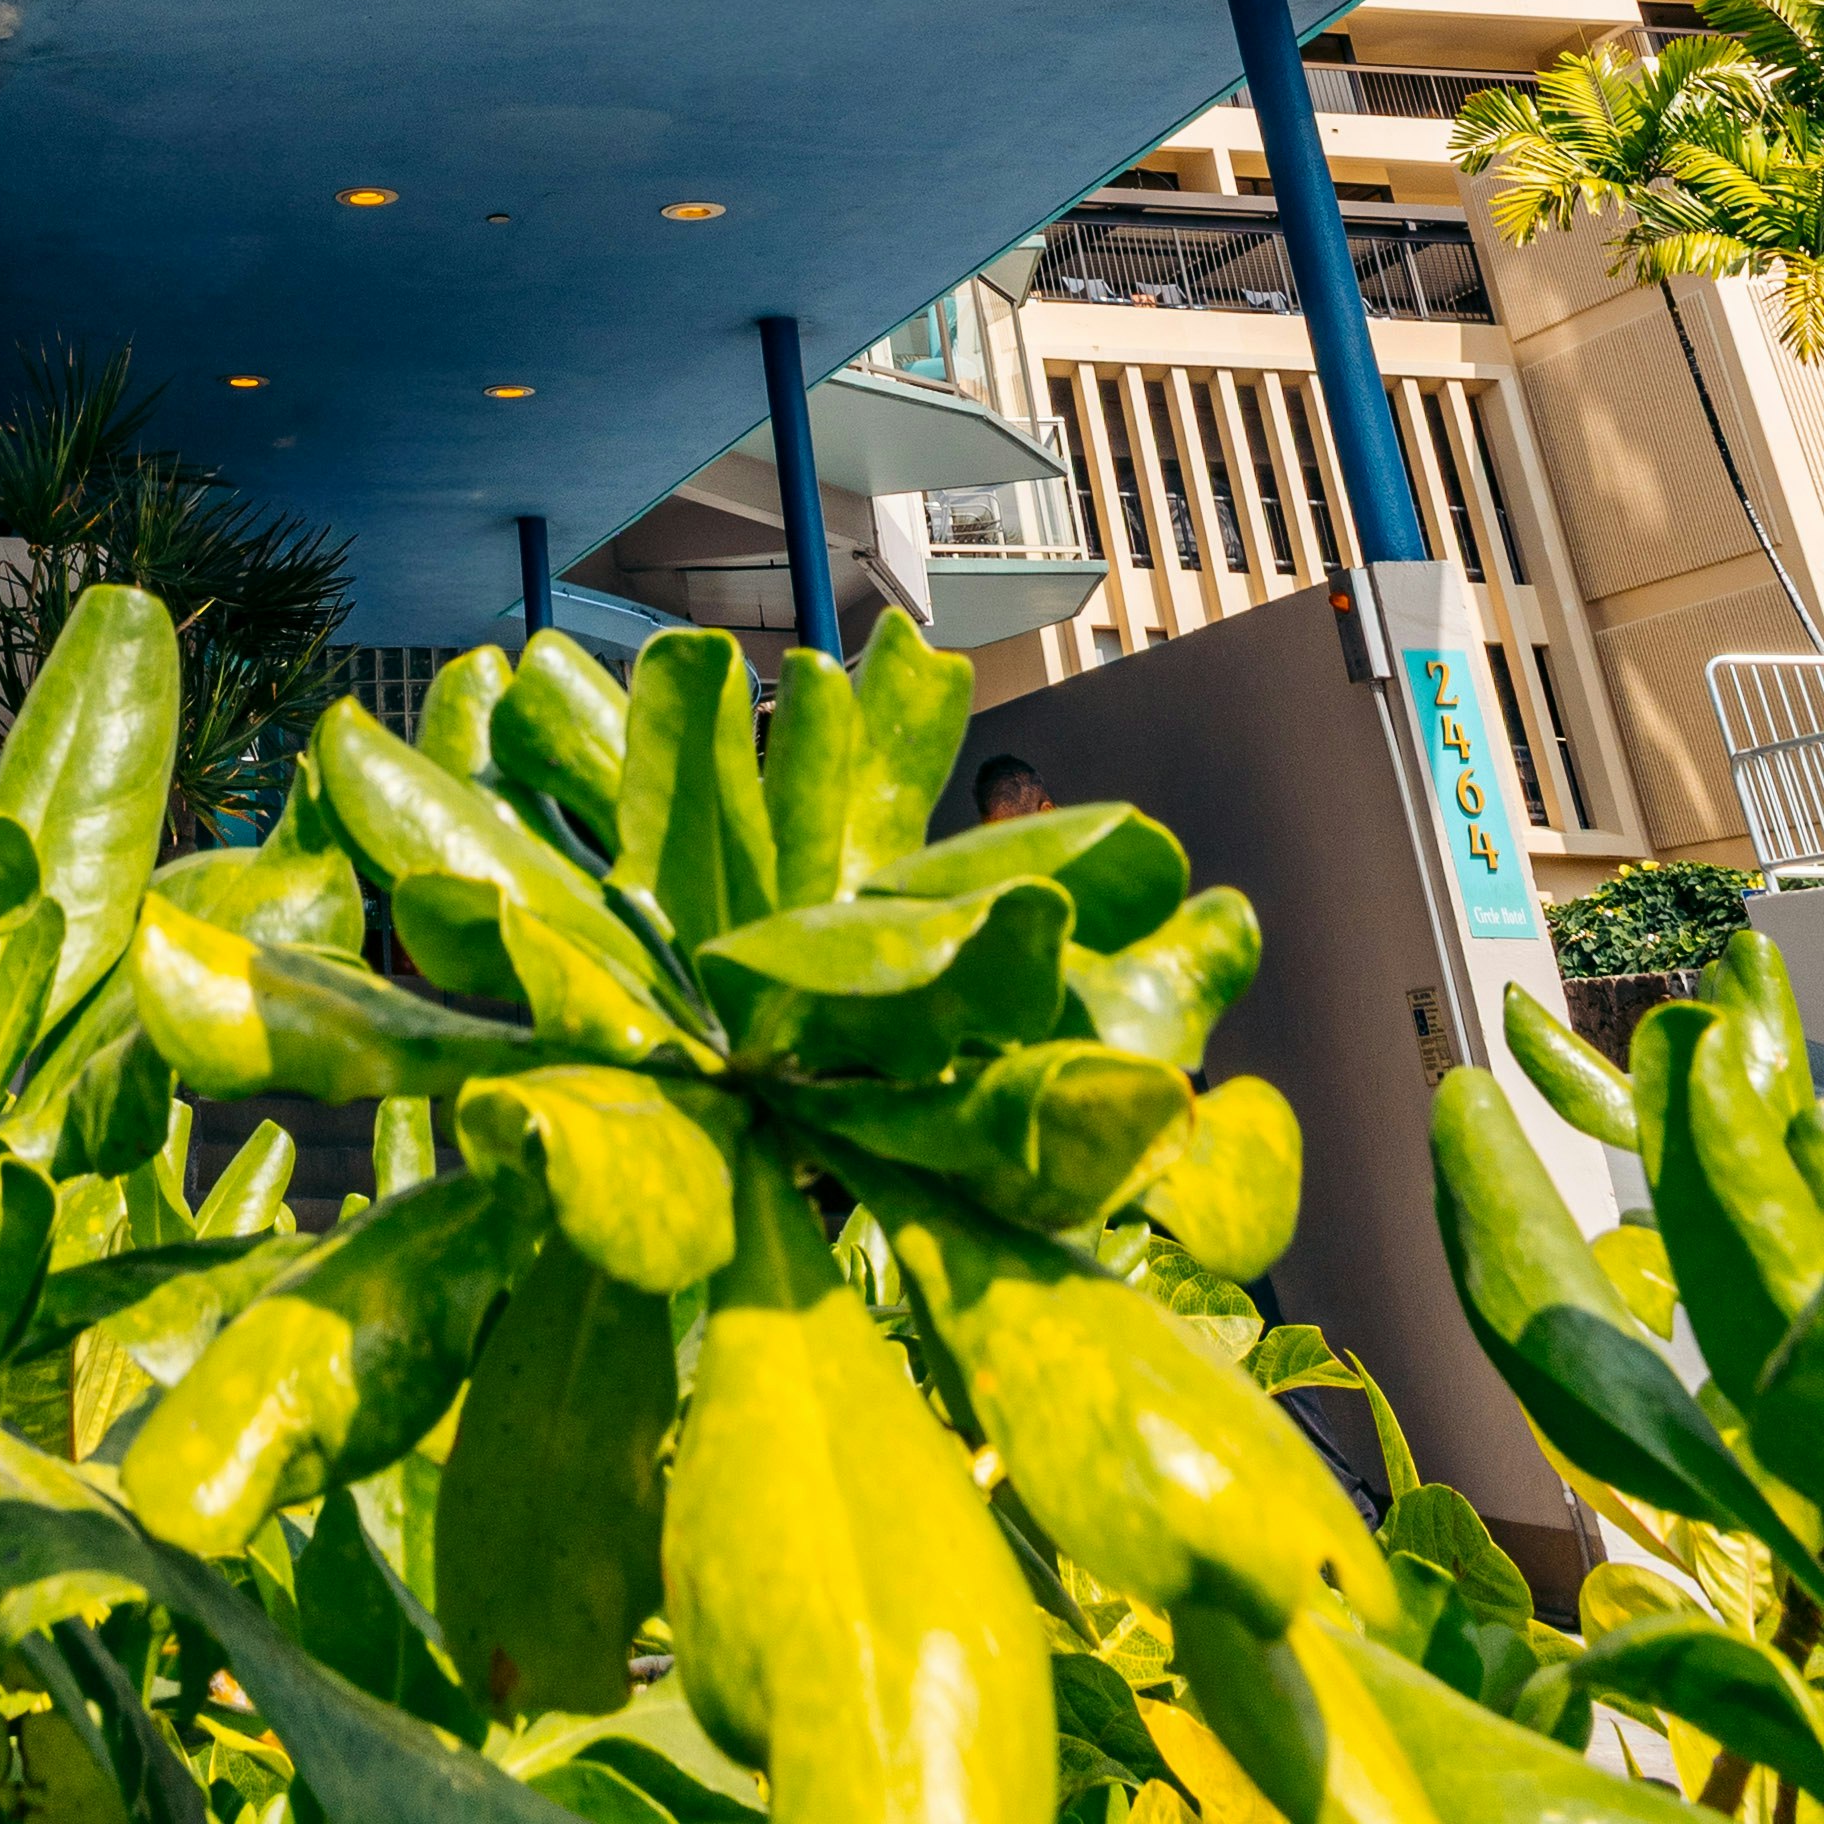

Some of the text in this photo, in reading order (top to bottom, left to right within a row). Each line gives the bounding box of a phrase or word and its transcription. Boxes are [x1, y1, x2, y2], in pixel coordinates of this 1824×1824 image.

[1426, 661, 1499, 871] 2464
[1473, 906, 1527, 925] Circle Hotel
